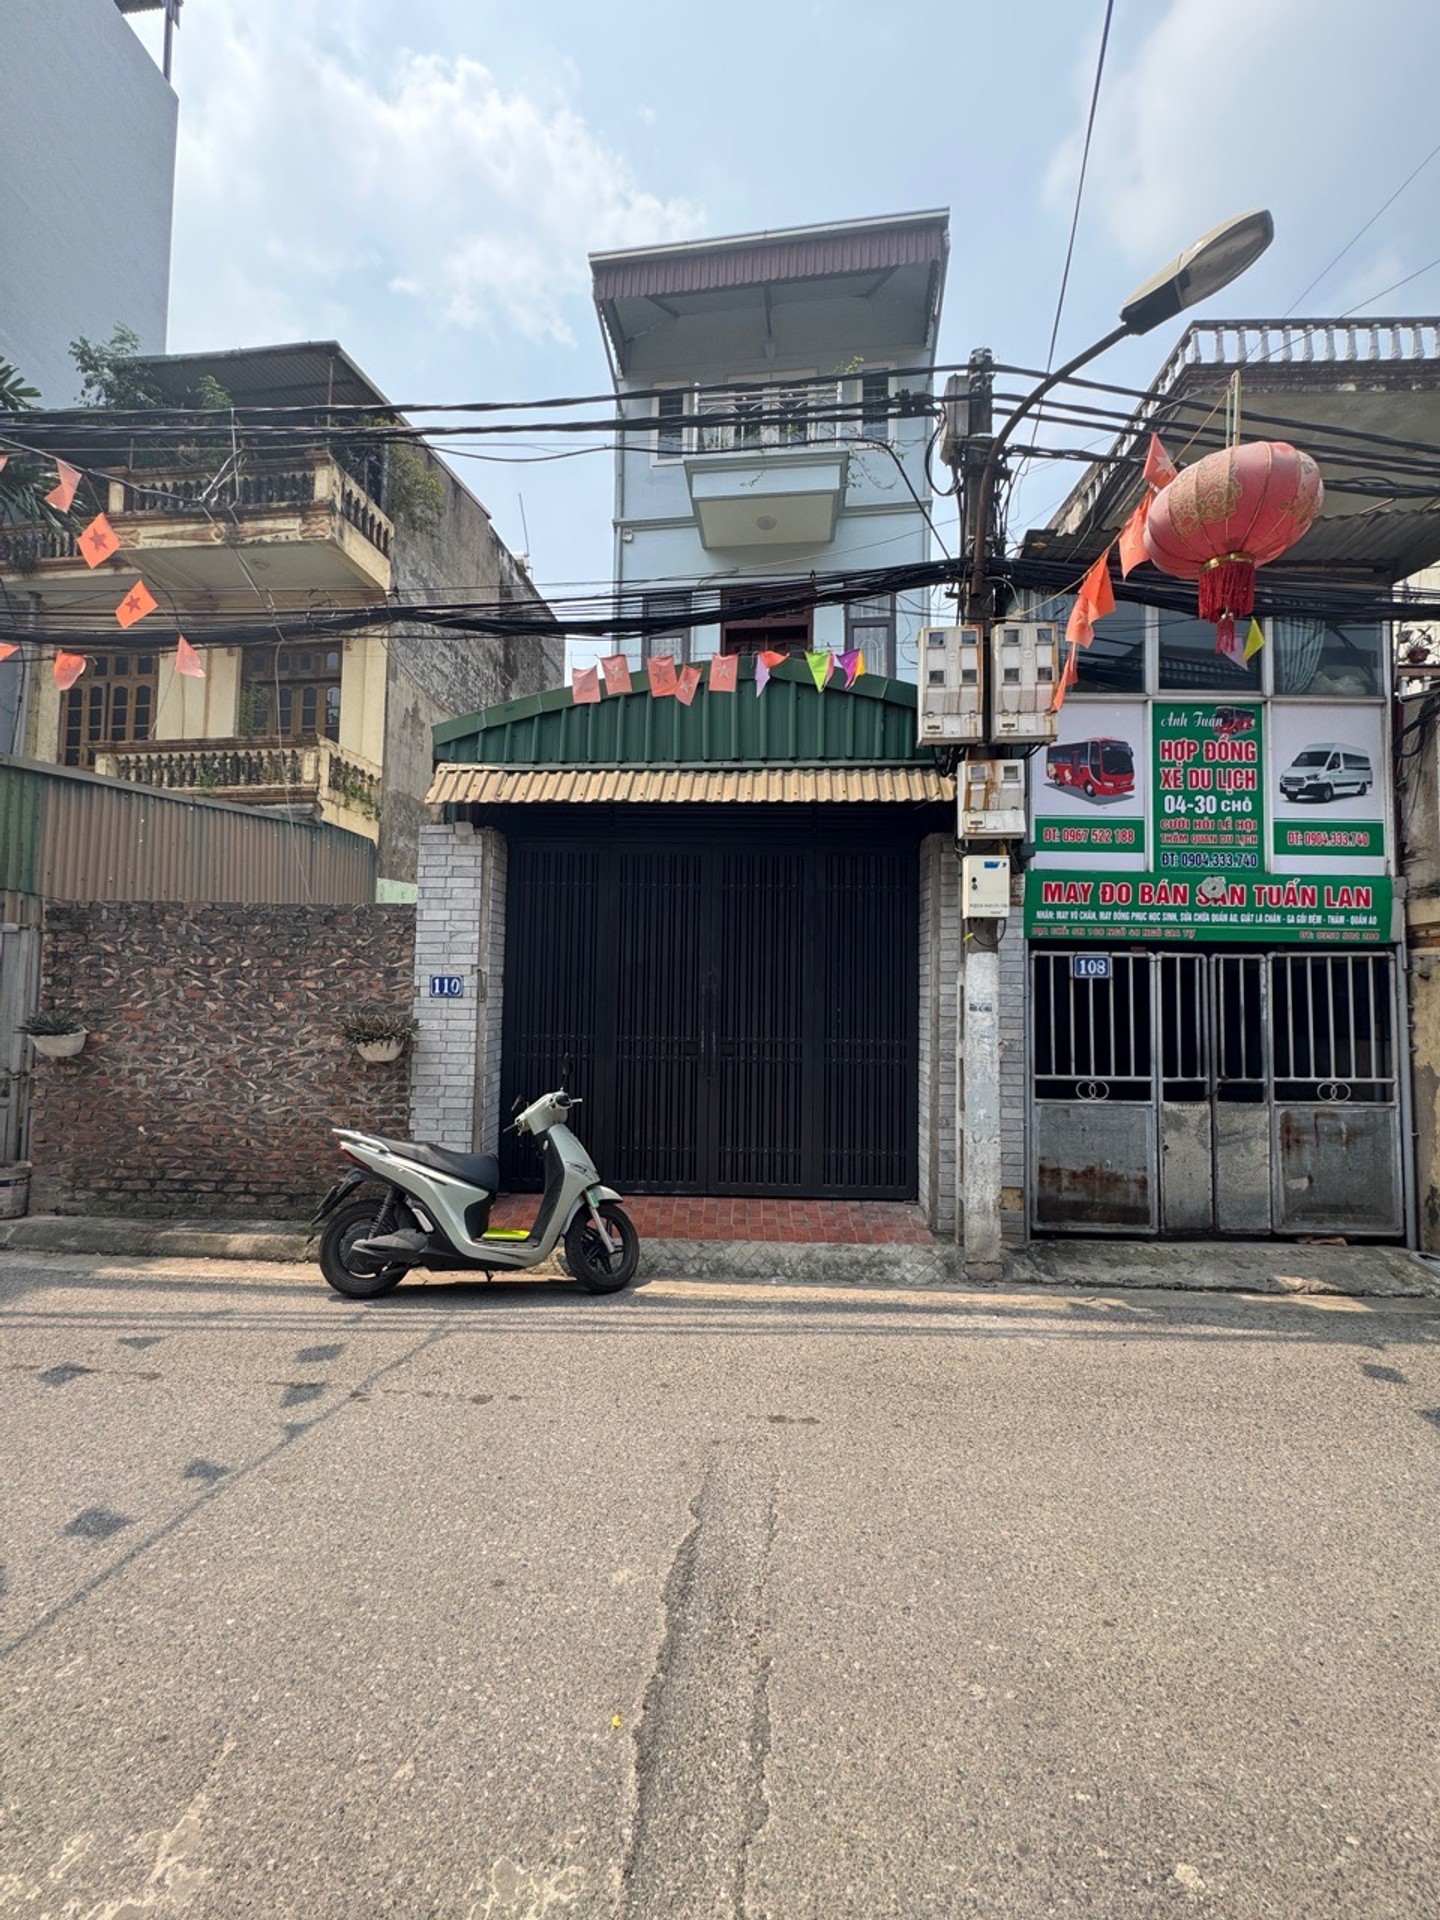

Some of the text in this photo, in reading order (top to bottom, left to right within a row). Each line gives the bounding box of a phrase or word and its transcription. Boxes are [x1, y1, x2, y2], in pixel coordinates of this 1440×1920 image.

[1160, 711, 1188, 728] Anh
[1160, 737, 1199, 767] HỢP
[1160, 767, 1257, 796] XE DU LỊCH
[1164, 794, 1217, 814] 04-30
[1062, 828, 1089, 843] 0967
[1091, 829, 1112, 843] 522
[1115, 829, 1135, 843] 188
[1304, 831, 1370, 847] 0904.333.740
[1181, 852, 1258, 868] 0904.333.740
[1042, 881, 1094, 904] MAY
[1099, 882, 1132, 905] ĐO
[1138, 879, 1189, 906] BÁN
[1253, 878, 1317, 908] TUẤN
[1324, 886, 1372, 909] LAN
[1079, 959, 1106, 975] 108
[433, 978, 460, 994] 110
